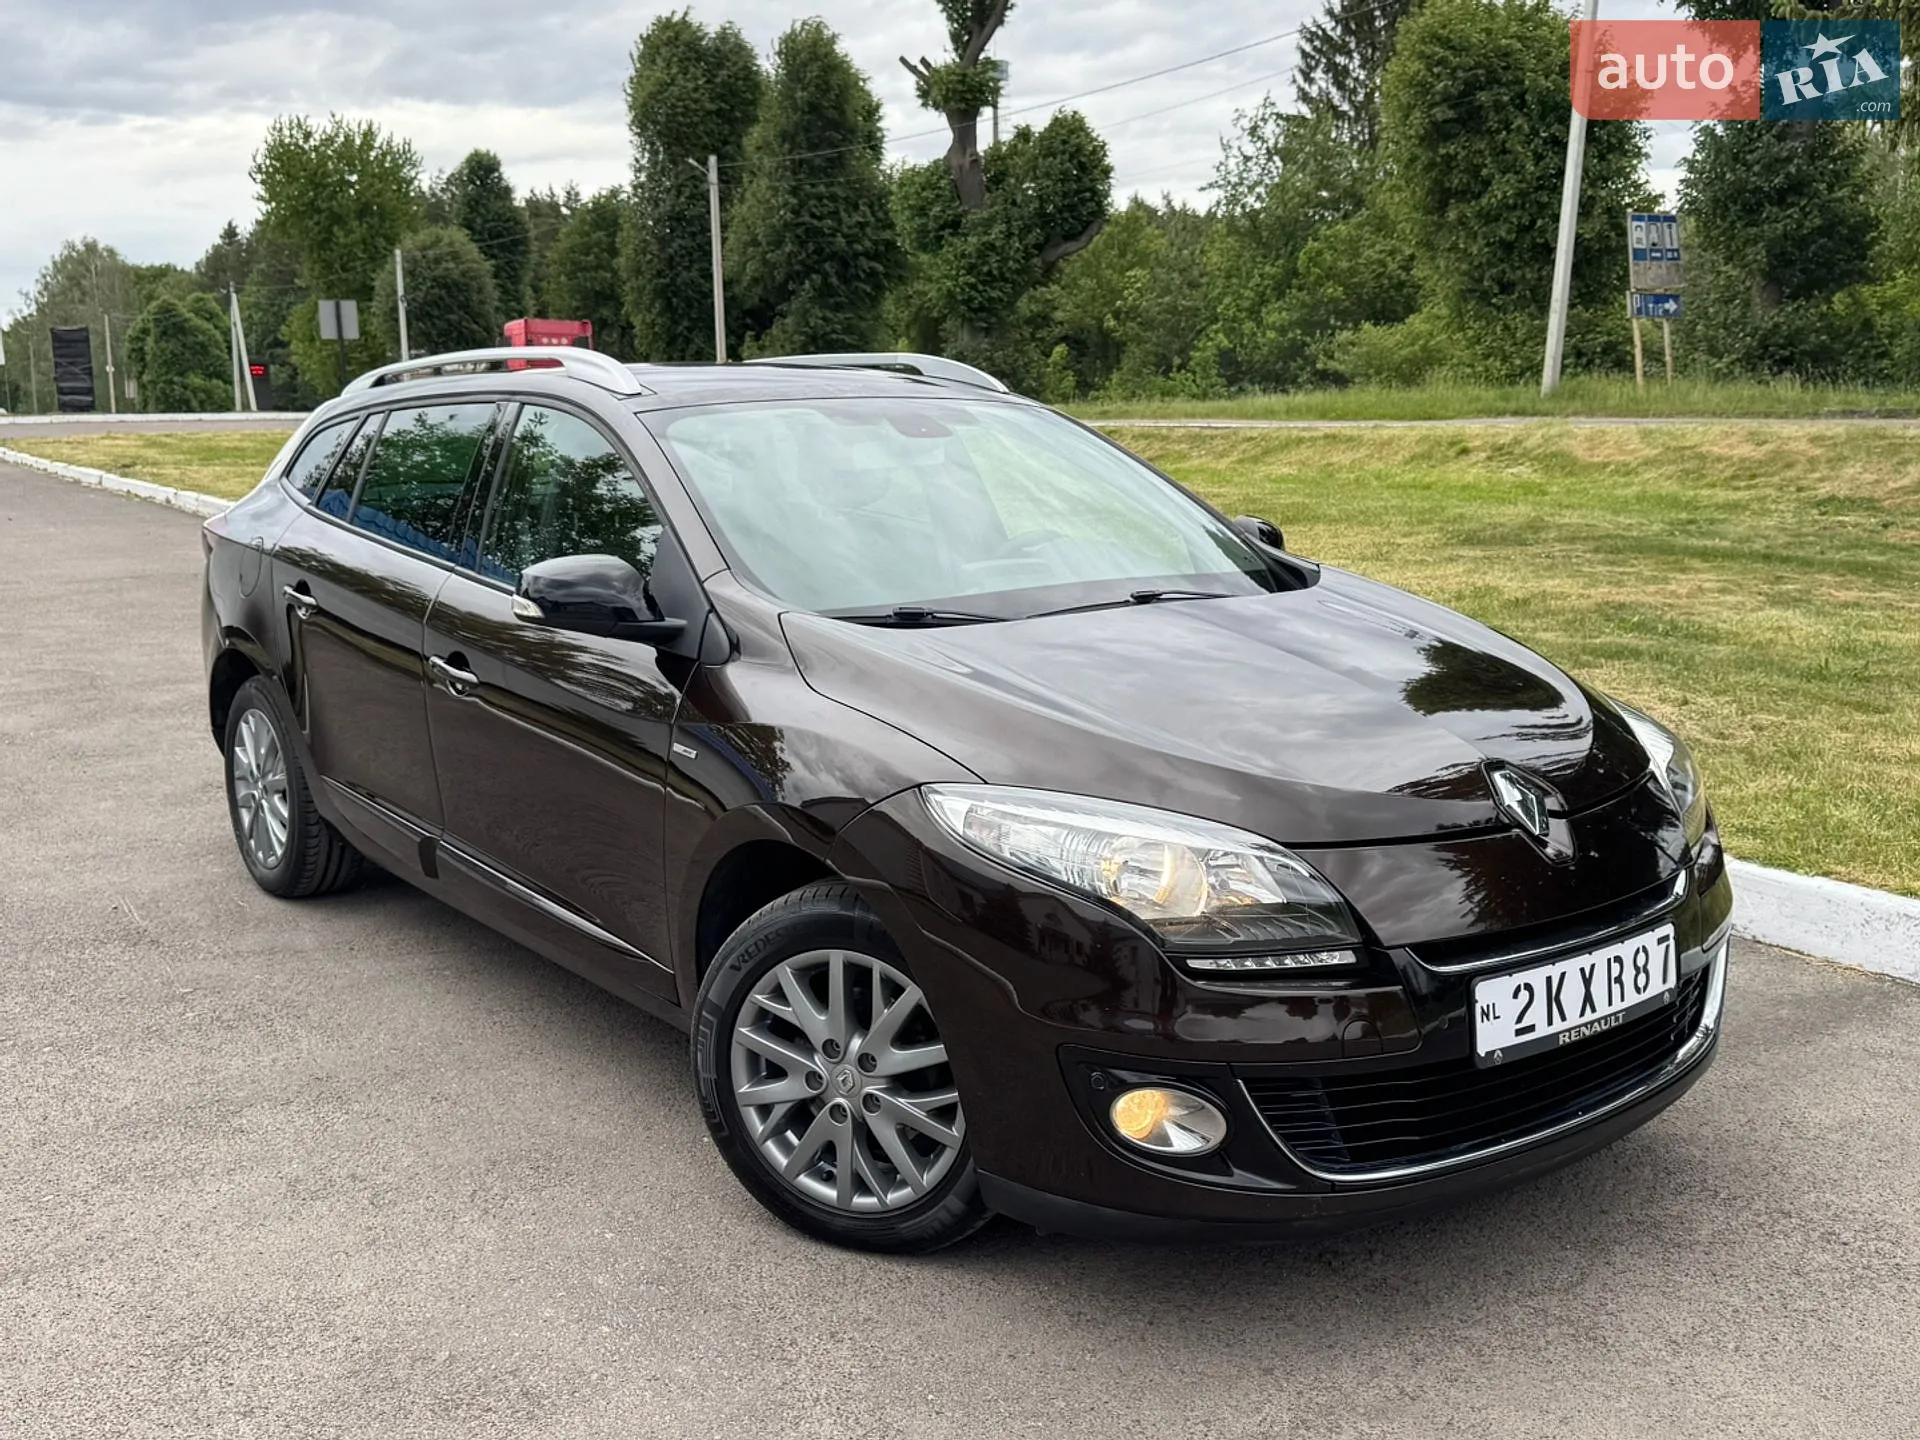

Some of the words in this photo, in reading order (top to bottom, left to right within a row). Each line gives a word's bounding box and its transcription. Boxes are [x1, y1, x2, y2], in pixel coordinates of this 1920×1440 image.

[1511, 933, 1671, 1038] 2KXR87
[1479, 1002, 1502, 1024] NL
[1558, 1012, 1626, 1046] RENAULT
